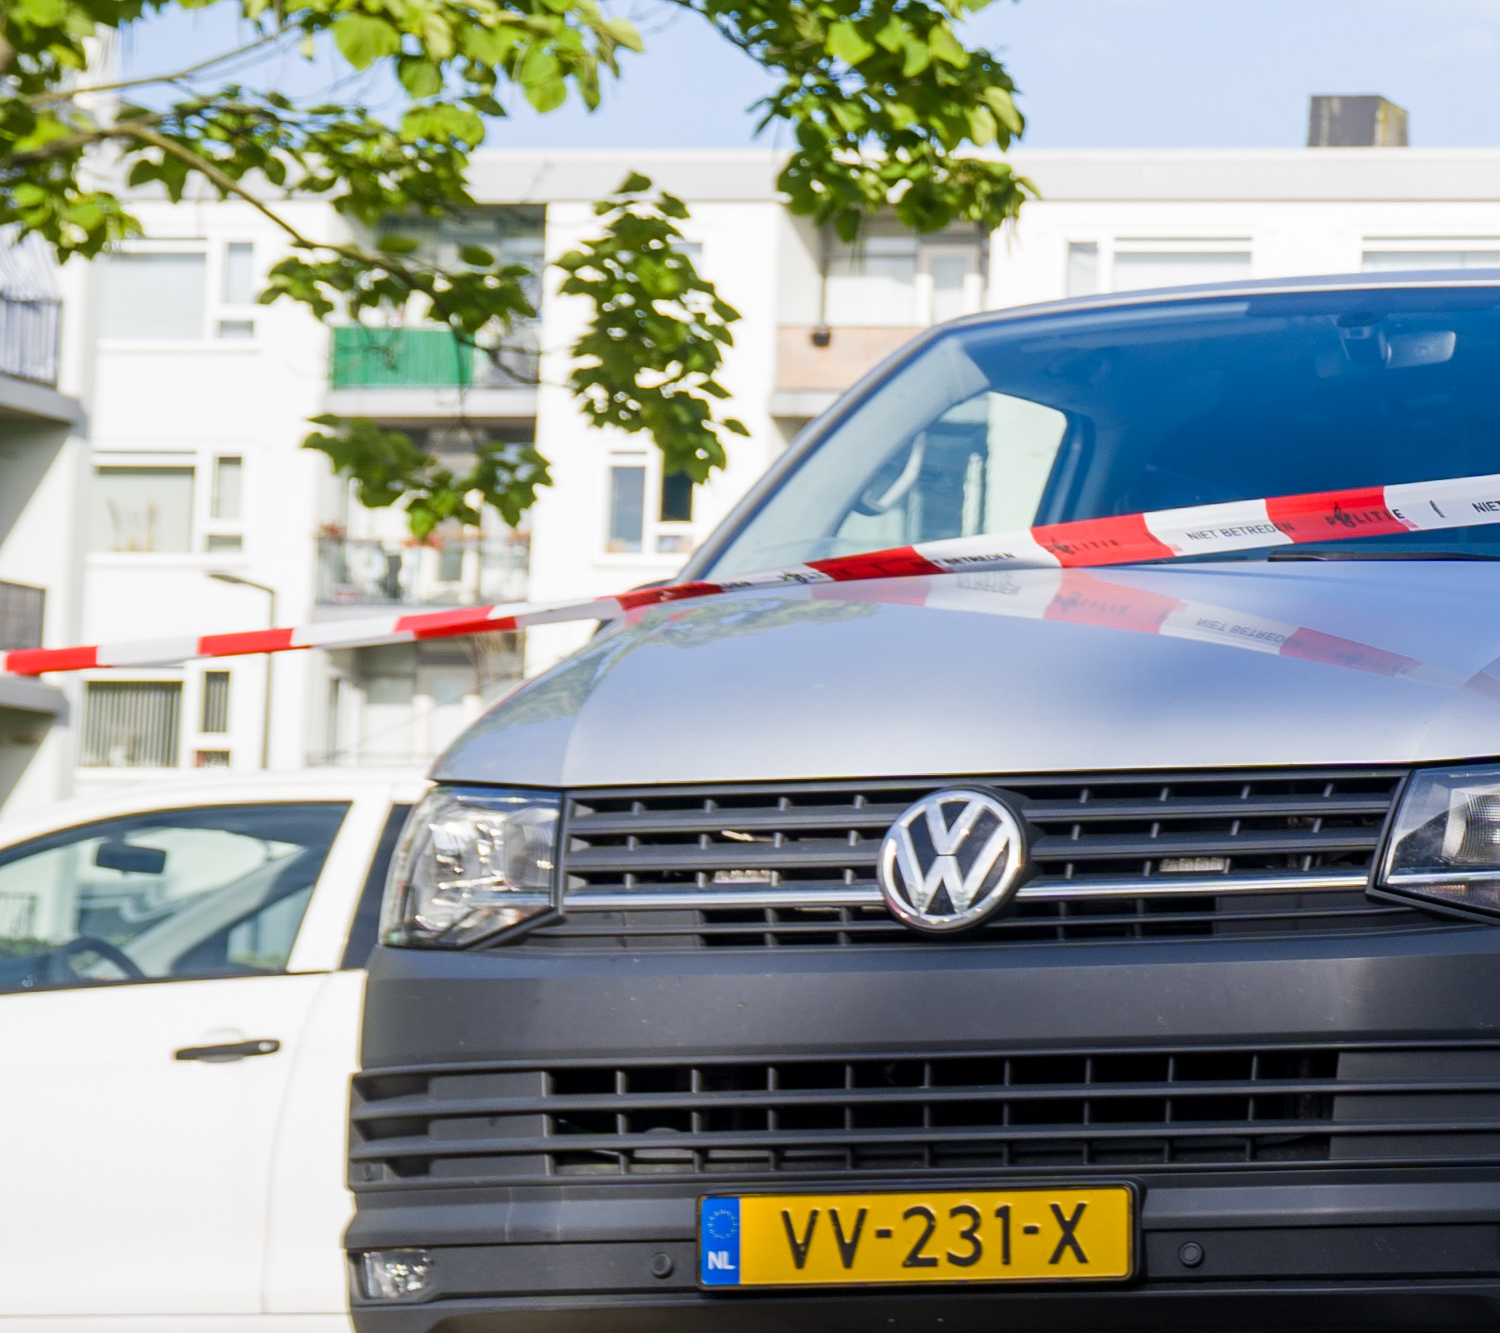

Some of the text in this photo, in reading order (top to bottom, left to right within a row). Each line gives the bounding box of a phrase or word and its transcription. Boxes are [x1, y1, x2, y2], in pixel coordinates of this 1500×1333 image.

[1186, 522, 1294, 542] NIET BETREDEN
[707, 1203, 1090, 1271] NL VV-231-X
